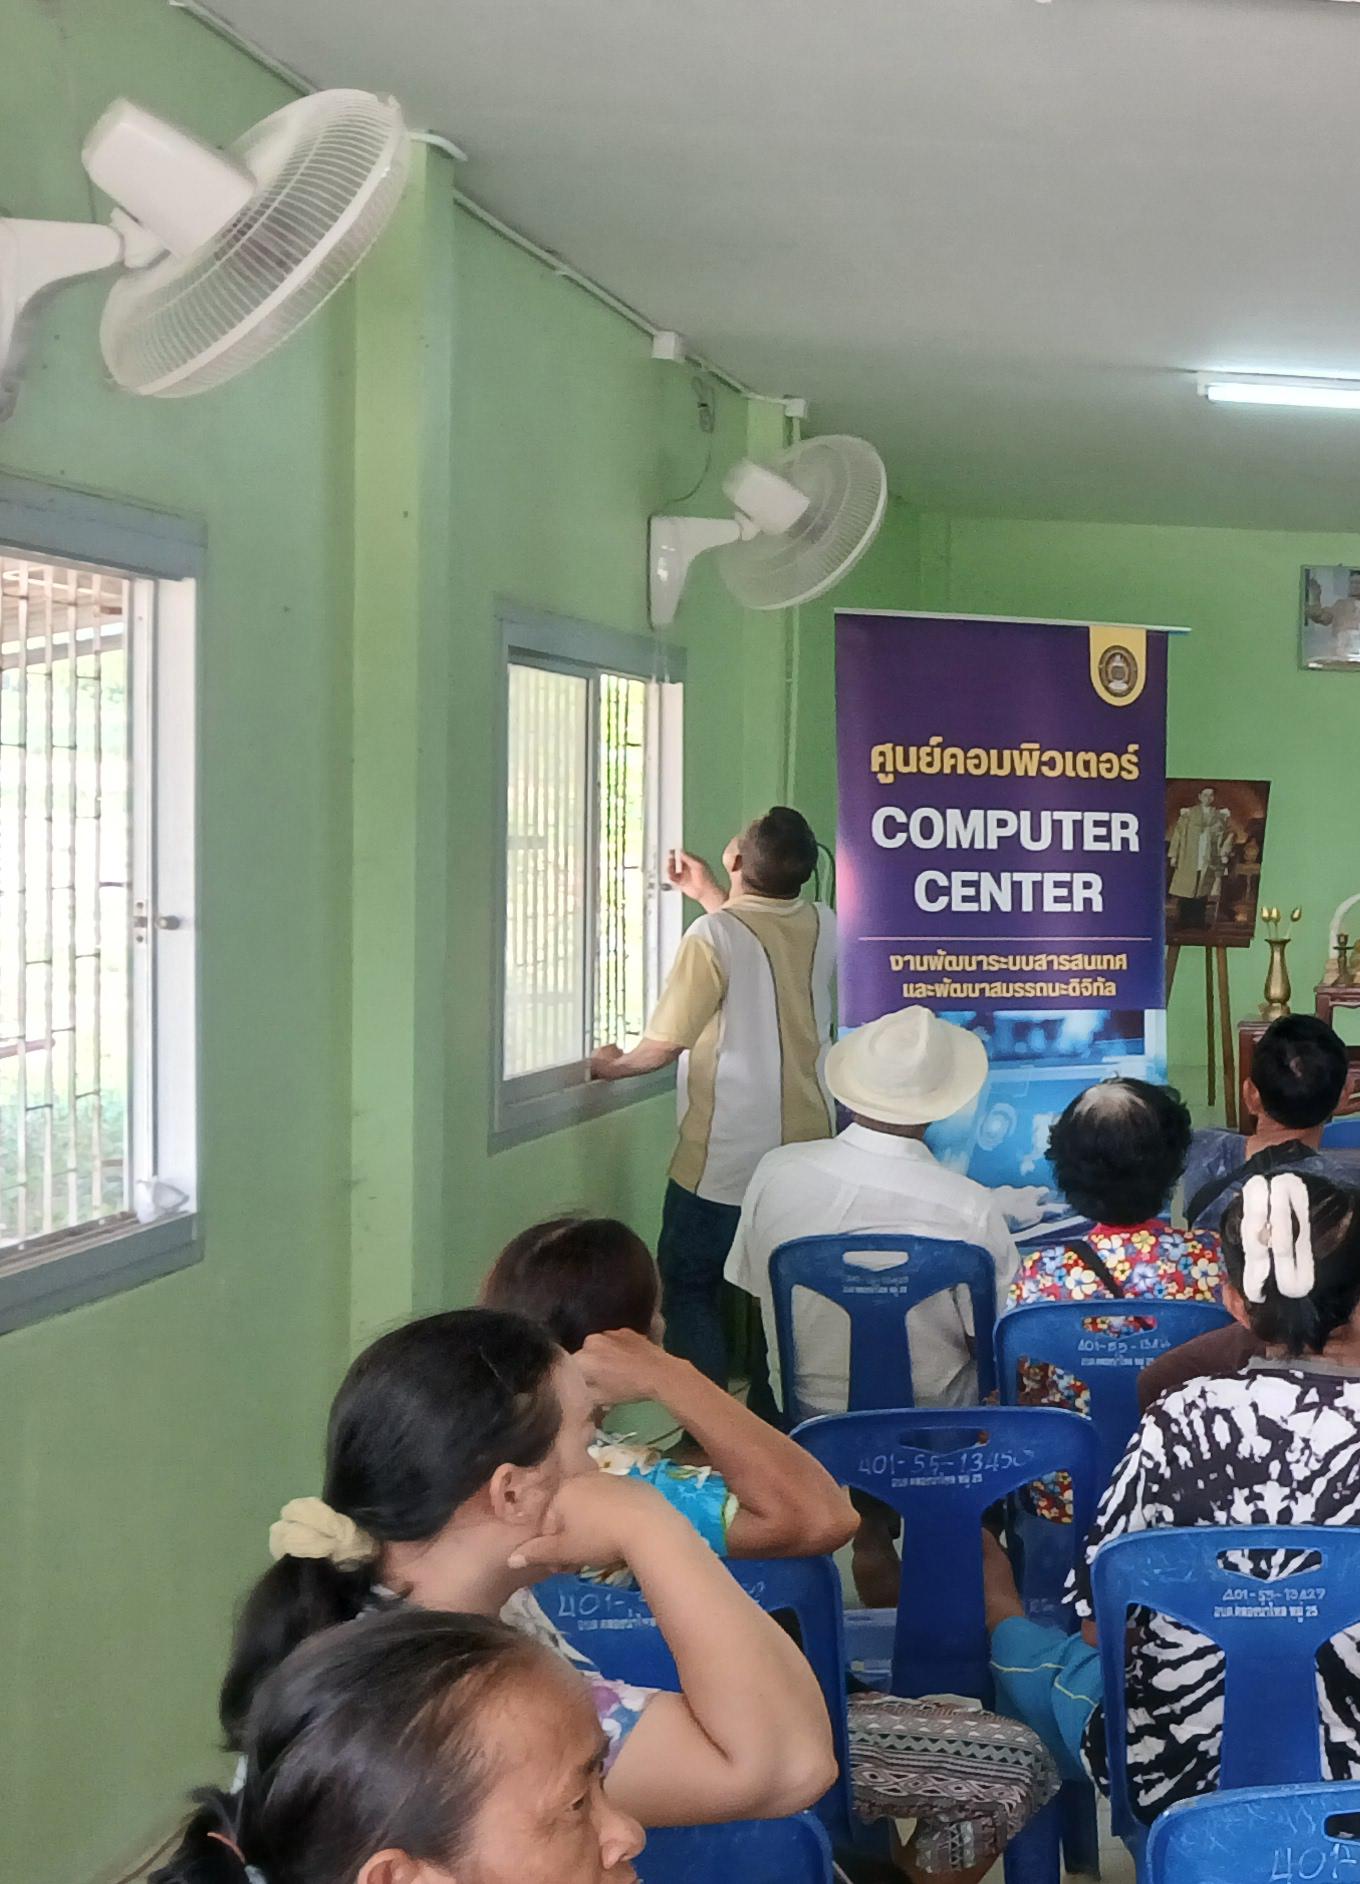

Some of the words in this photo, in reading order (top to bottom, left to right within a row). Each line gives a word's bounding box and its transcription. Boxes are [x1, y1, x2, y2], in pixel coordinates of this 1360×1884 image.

[870, 736, 1140, 784] ศูนย์คอมพิวเตอร์
[870, 806, 1140, 852] COMPUTER
[914, 870, 1103, 913] CENTER
[889, 948, 1128, 972] งานพัฒนาระบบสารสนเทศ
[902, 977, 1117, 998] และพัฒนาสมรรถนะดิจิทัล
